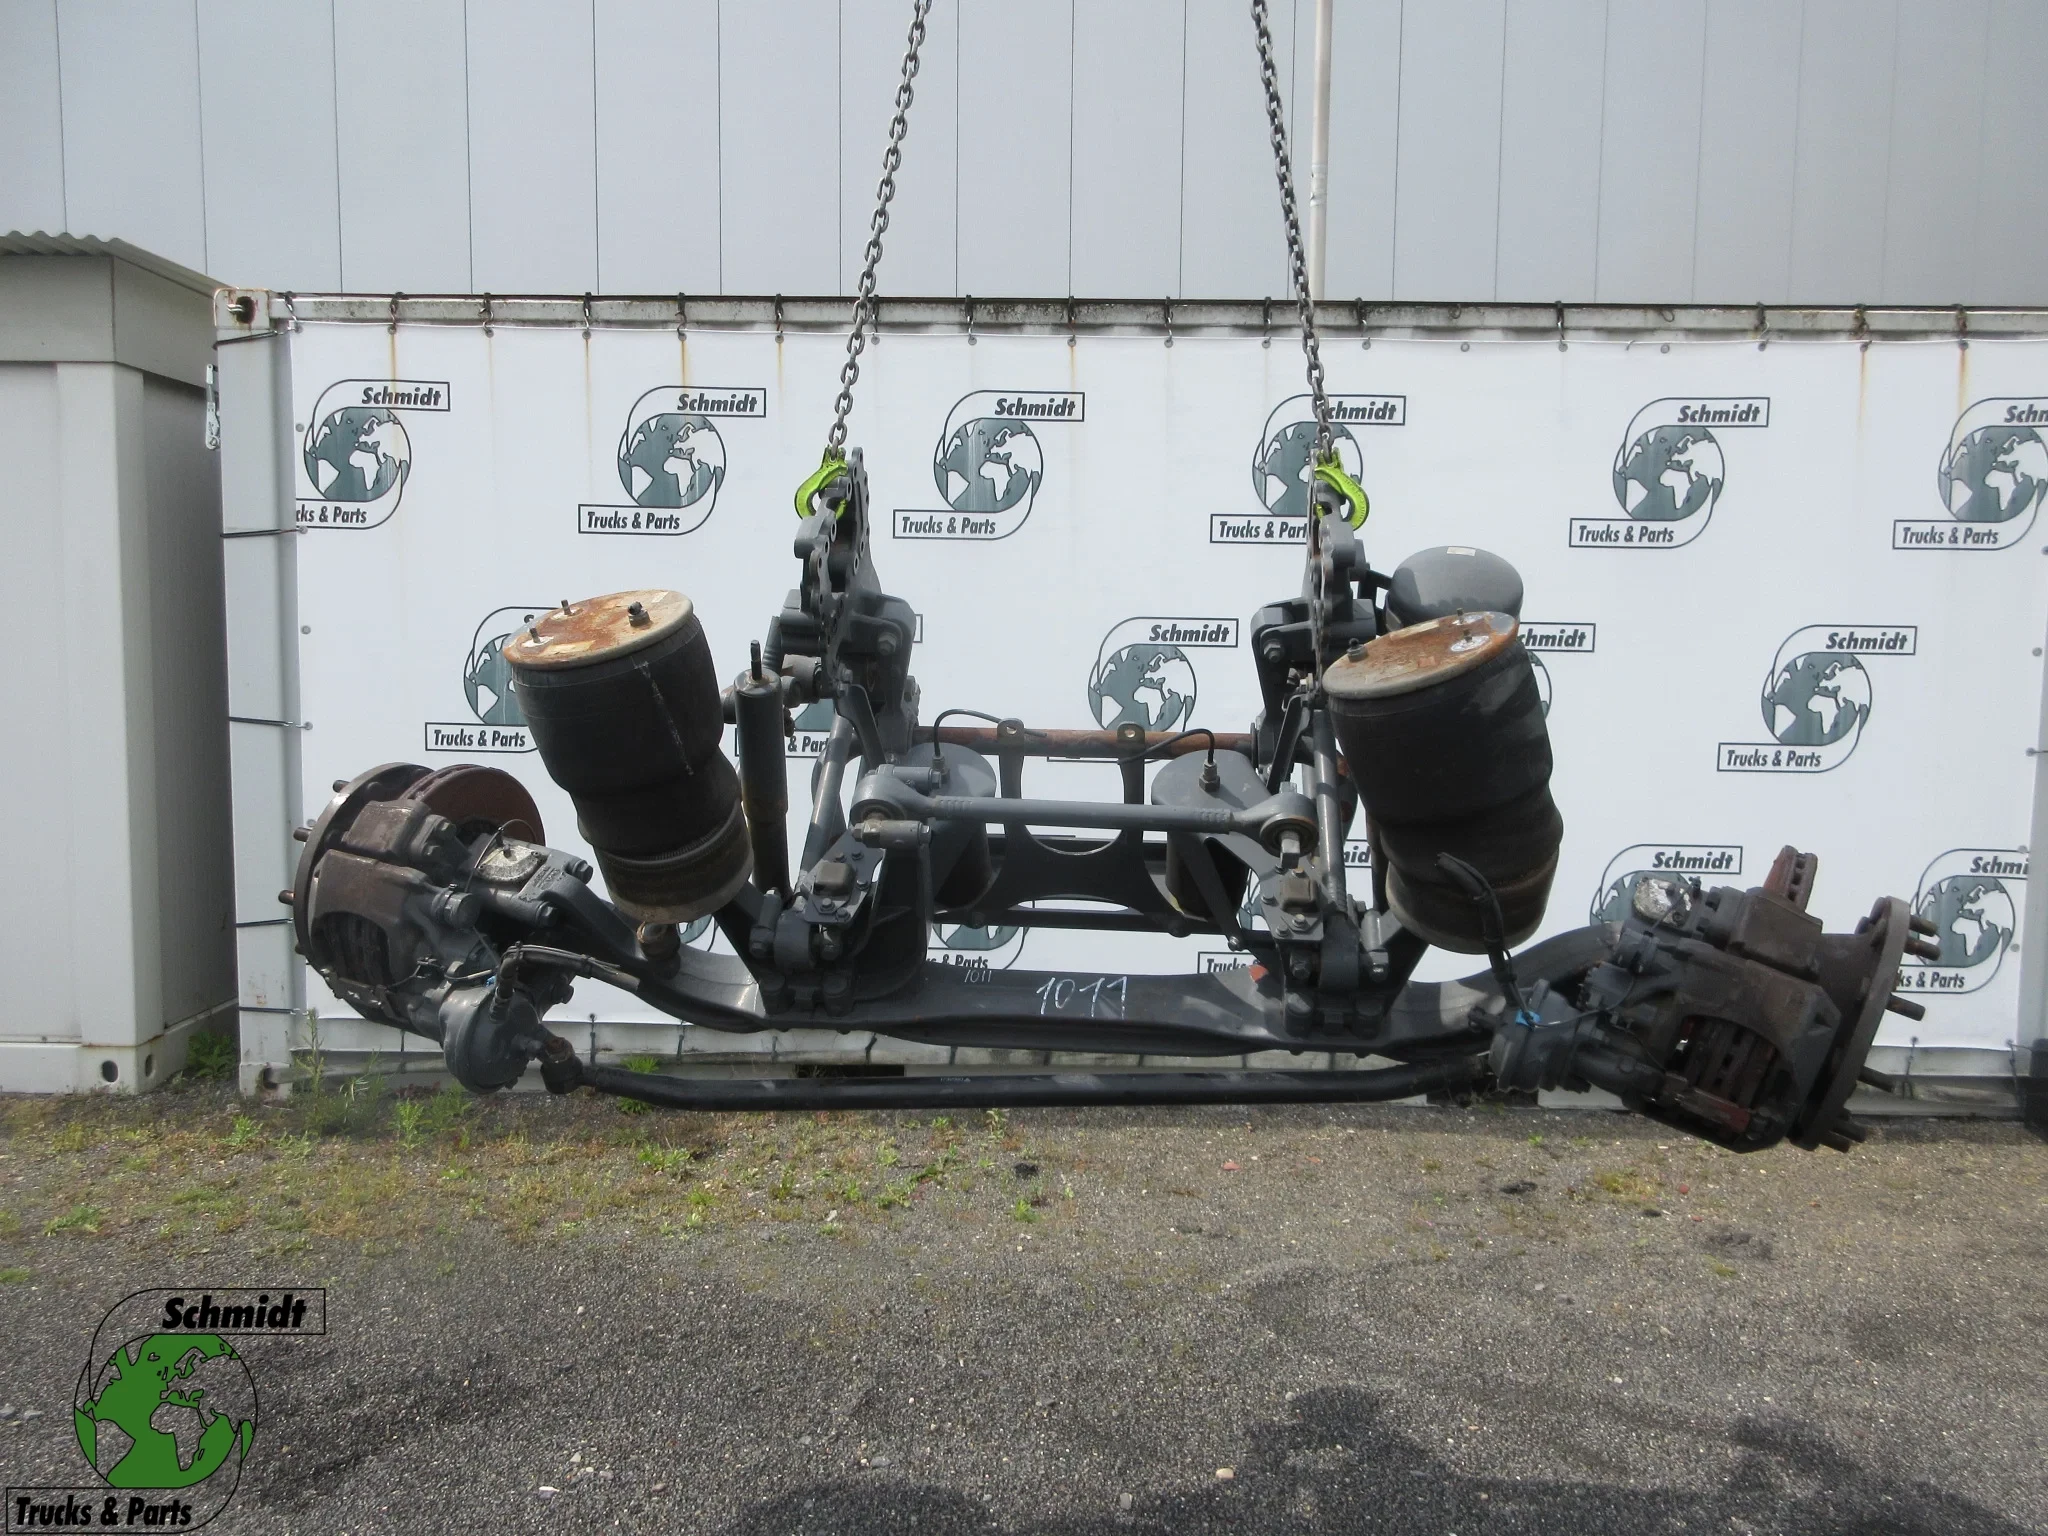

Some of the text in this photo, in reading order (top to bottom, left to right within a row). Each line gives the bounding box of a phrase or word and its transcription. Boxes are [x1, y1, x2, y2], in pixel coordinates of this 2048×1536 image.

[361, 386, 441, 406] Schmidt
[677, 394, 758, 412] Schmidt
[995, 398, 1075, 417] Schmidt
[1327, 401, 1396, 420] chmidt
[1677, 404, 1760, 423] Schmidt
[296, 504, 367, 523] cks & Parts
[587, 511, 680, 530] Trucks & Parts
[902, 516, 996, 535] Trucks & Parts
[1220, 520, 1307, 538] Trucks & Part
[1579, 525, 1674, 543] Trucks & Parts
[1903, 526, 1999, 545] Trucks & Parts
[1149, 624, 1229, 643] Schmidt
[1825, 632, 1907, 650] Schmidt
[434, 729, 526, 748] Trucks & Parts
[788, 736, 829, 752] & Par
[1727, 749, 1821, 767] Trucks & Parts
[1652, 851, 1733, 870] Schmidt
[1970, 856, 2028, 874] Schmi
[964, 969, 992, 983] 1011
[1916, 971, 1926, 988] &
[1931, 972, 1965, 988] Parts
[1036, 976, 1127, 1019] 1011
